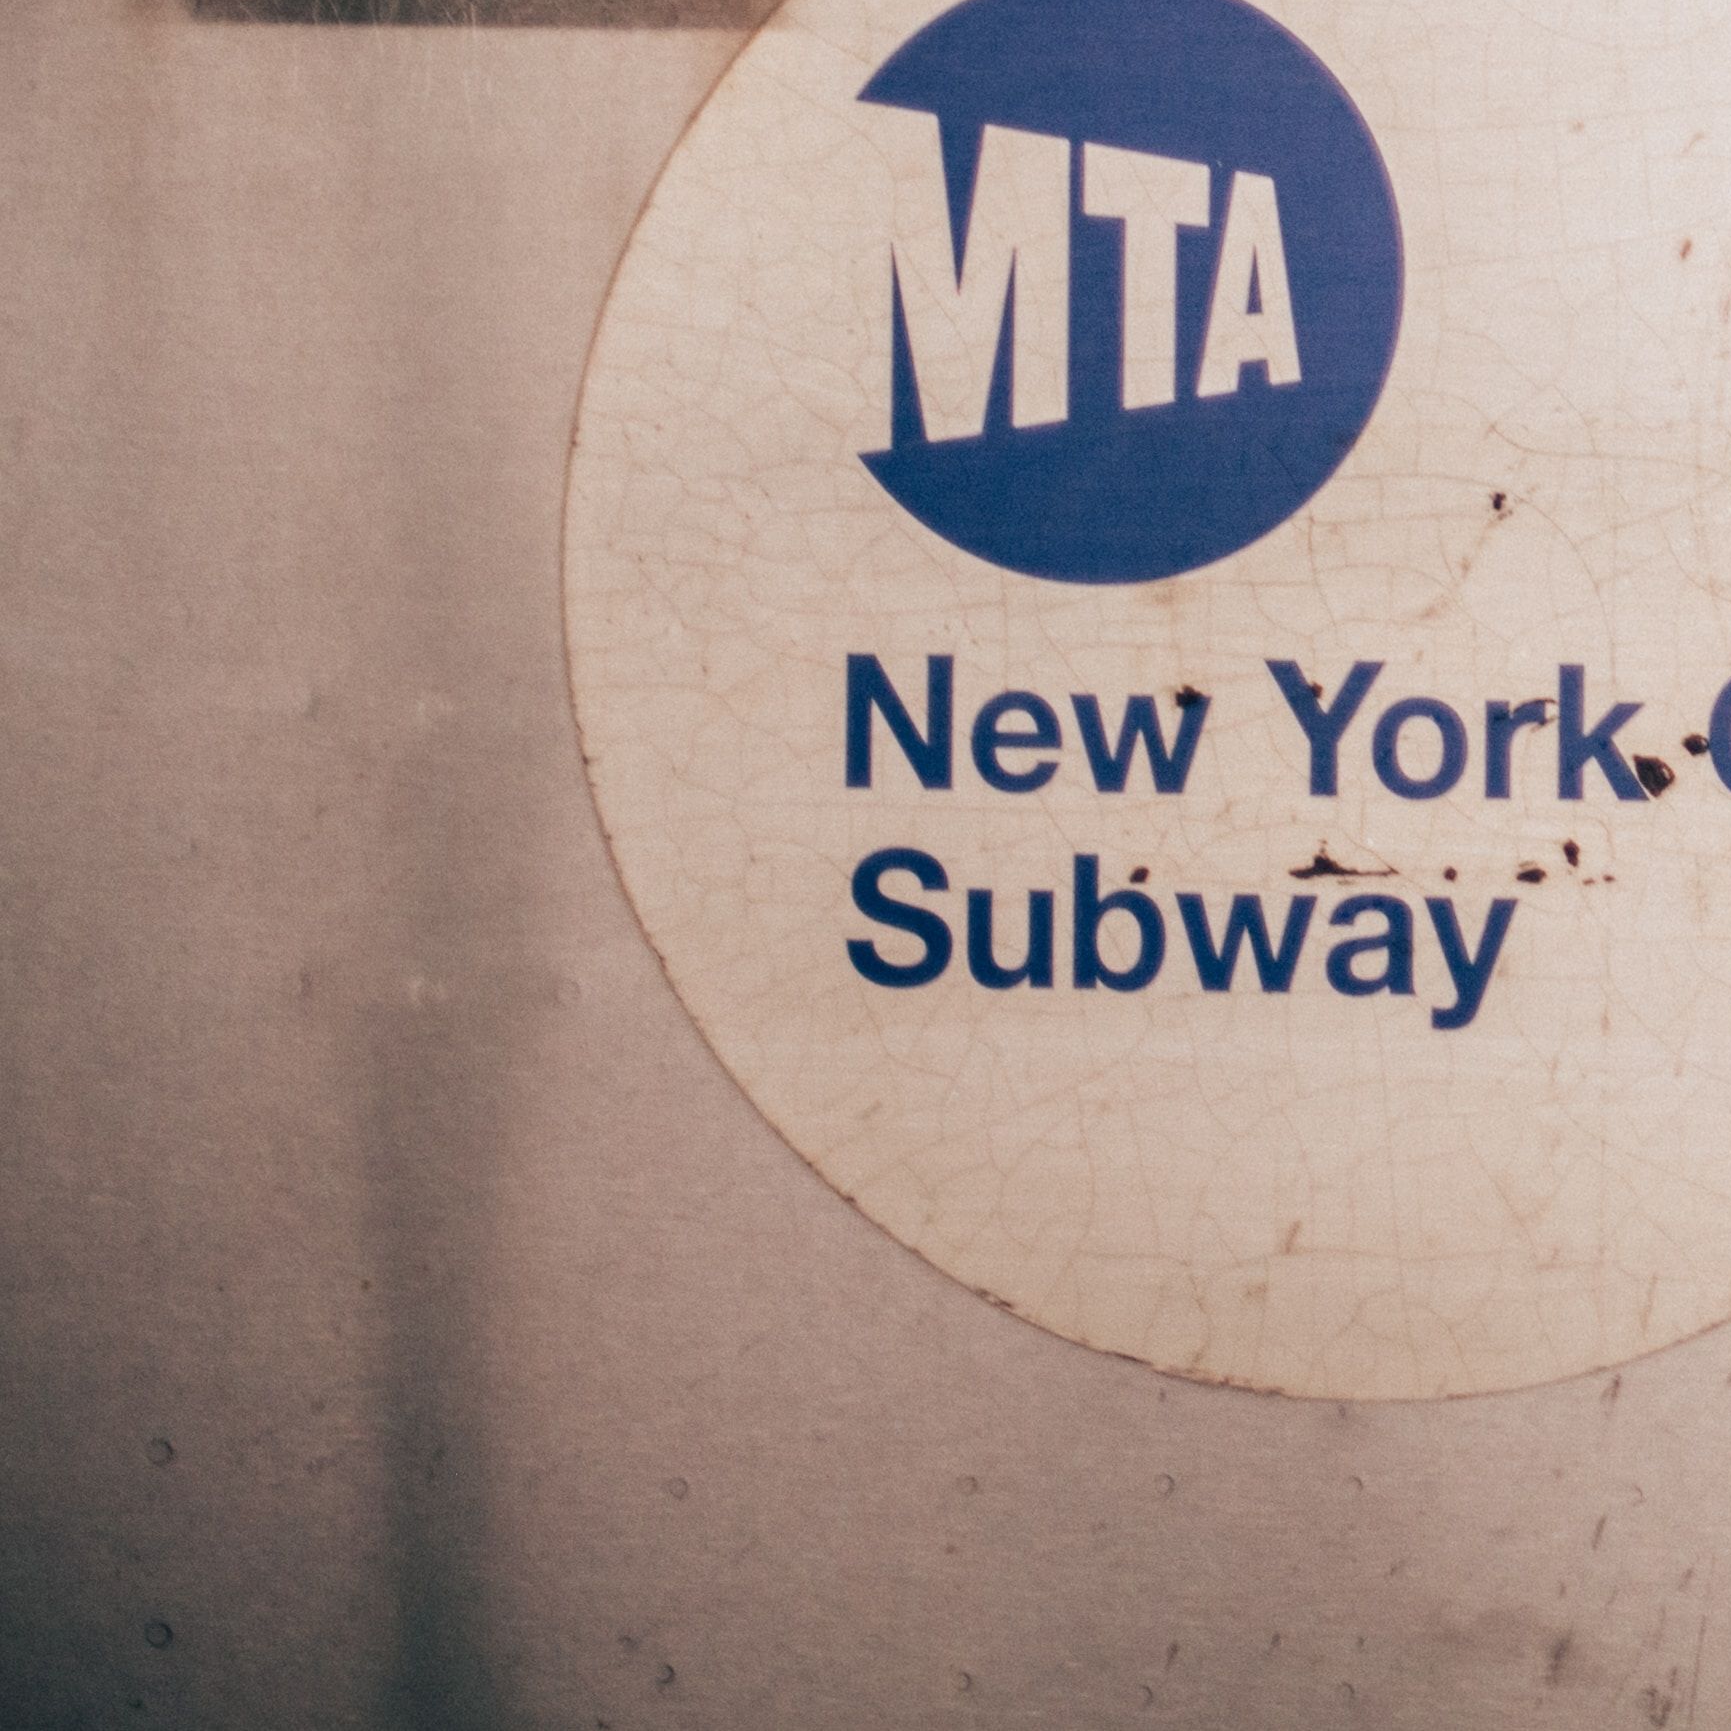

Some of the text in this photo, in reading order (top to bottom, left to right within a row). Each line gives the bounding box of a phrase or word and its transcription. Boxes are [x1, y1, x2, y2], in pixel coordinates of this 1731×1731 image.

[858, 98, 1302, 451] MTA
[844, 654, 1211, 794] New
[1265, 661, 1646, 801] York
[845, 848, 1517, 1031] Subway
